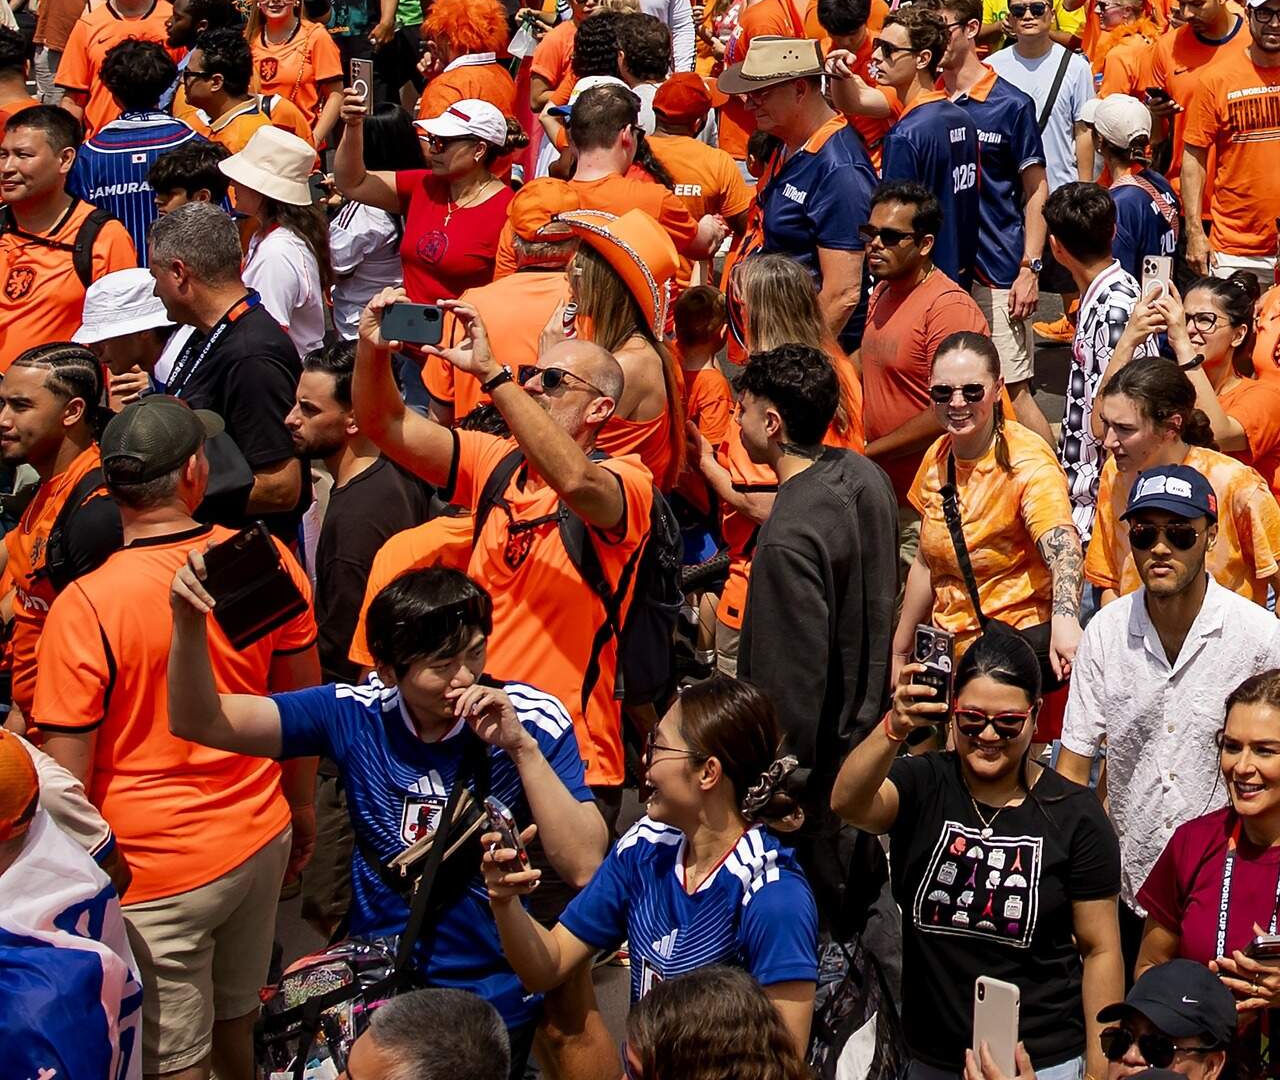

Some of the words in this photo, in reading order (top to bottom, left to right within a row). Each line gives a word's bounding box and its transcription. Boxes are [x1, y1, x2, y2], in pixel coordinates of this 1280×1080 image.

[1227, 90, 1243, 101] FIFA
[1243, 87, 1267, 99] WORLD
[90, 181, 155, 201] SAMURA
[674, 183, 702, 197] EER
[1223, 857, 1234, 877] FIFA
[1220, 877, 1232, 911] WORLD
[1218, 911, 1229, 931] CUP
